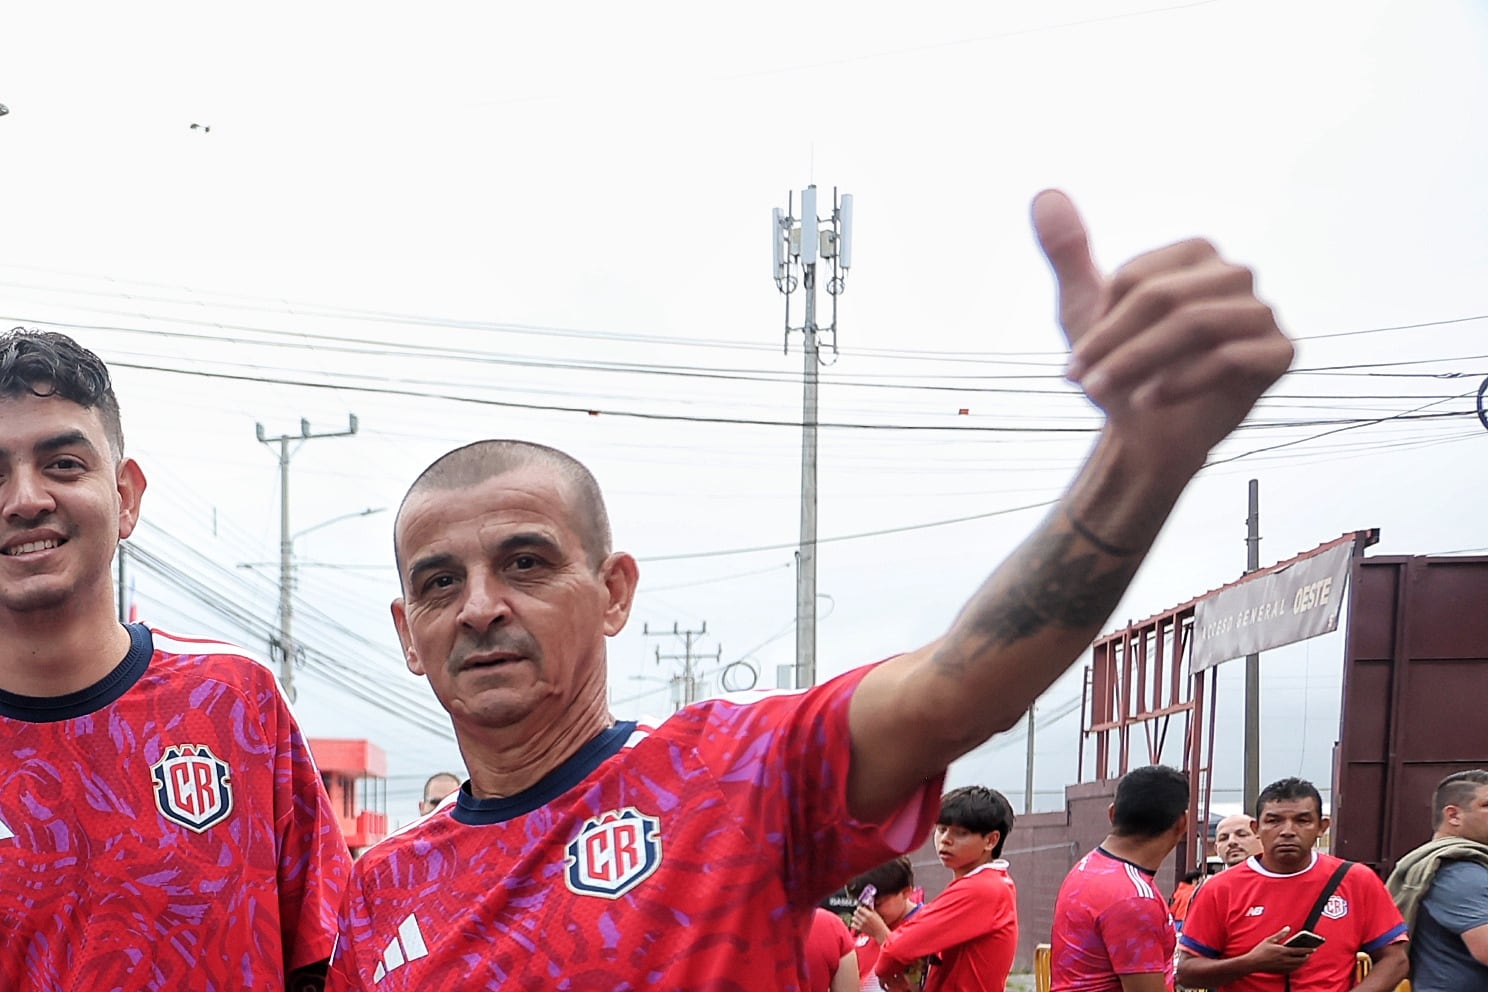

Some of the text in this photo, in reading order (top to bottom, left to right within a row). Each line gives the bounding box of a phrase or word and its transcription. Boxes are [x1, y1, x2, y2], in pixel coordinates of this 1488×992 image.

[1202, 576, 1332, 640] ACCESO GENERAL OESTE
[169, 761, 216, 817] CR
[585, 824, 640, 882] CR
